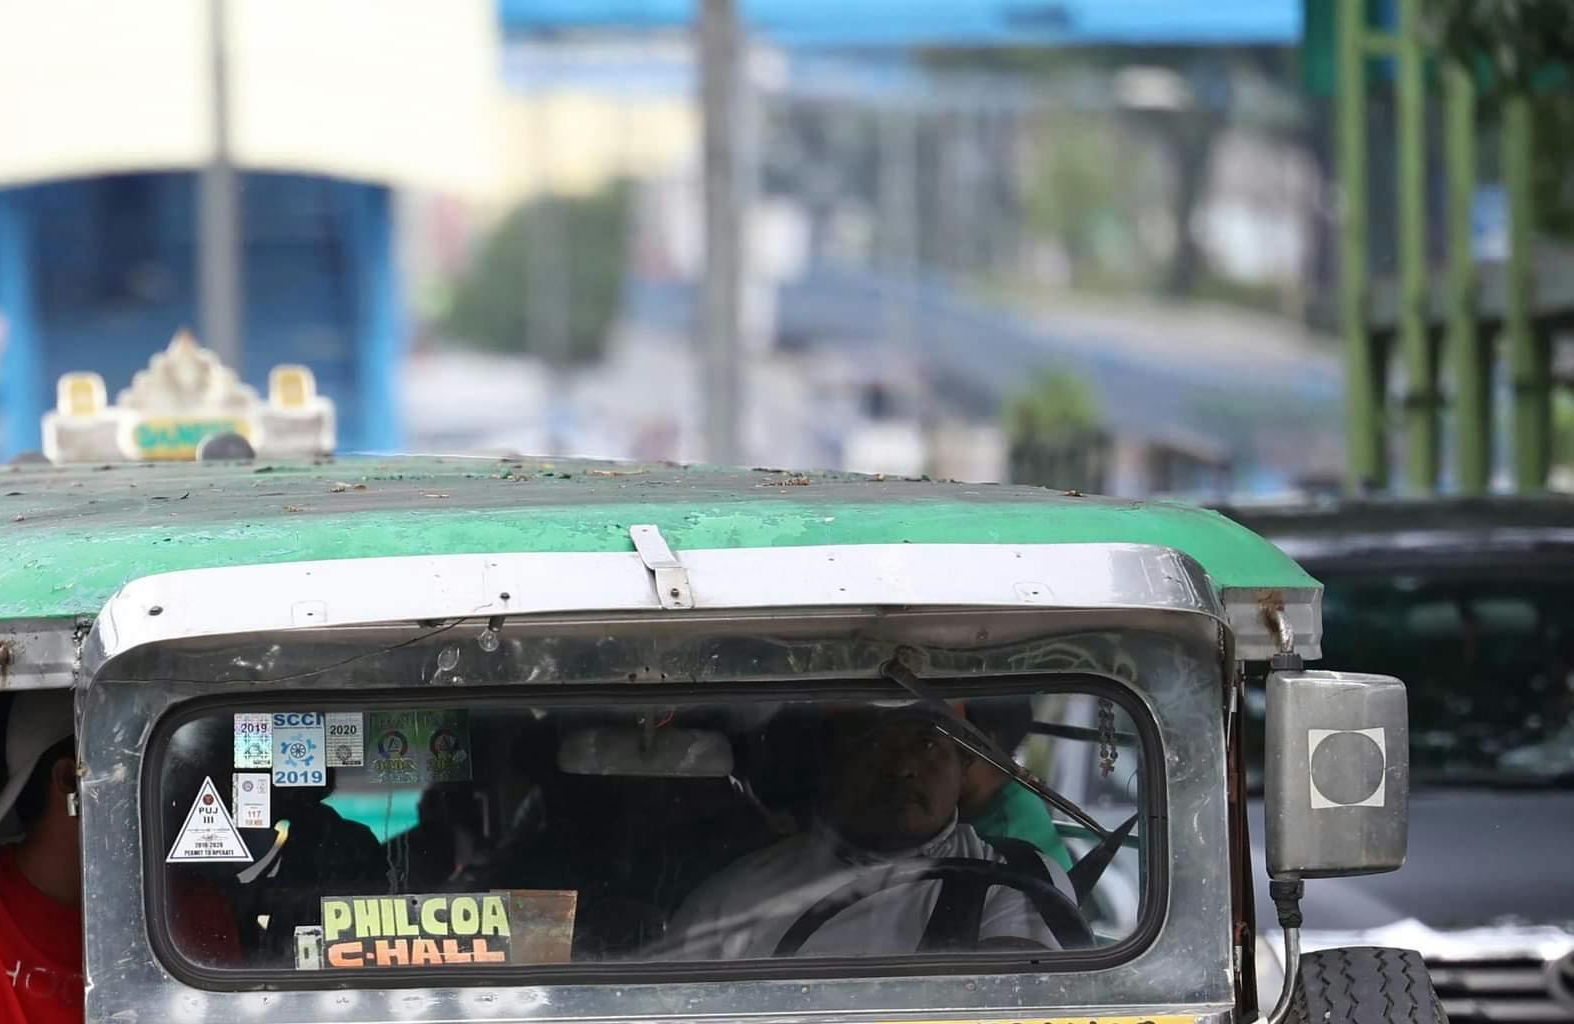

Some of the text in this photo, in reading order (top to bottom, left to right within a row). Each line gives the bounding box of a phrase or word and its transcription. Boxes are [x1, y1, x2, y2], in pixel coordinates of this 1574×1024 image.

[273, 712, 322, 727] SCCI
[240, 723, 268, 734] 2019
[329, 724, 357, 735] 2020
[275, 770, 323, 784] 2019
[324, 896, 510, 941] PHILCOA
[328, 937, 505, 967] C-HALL
